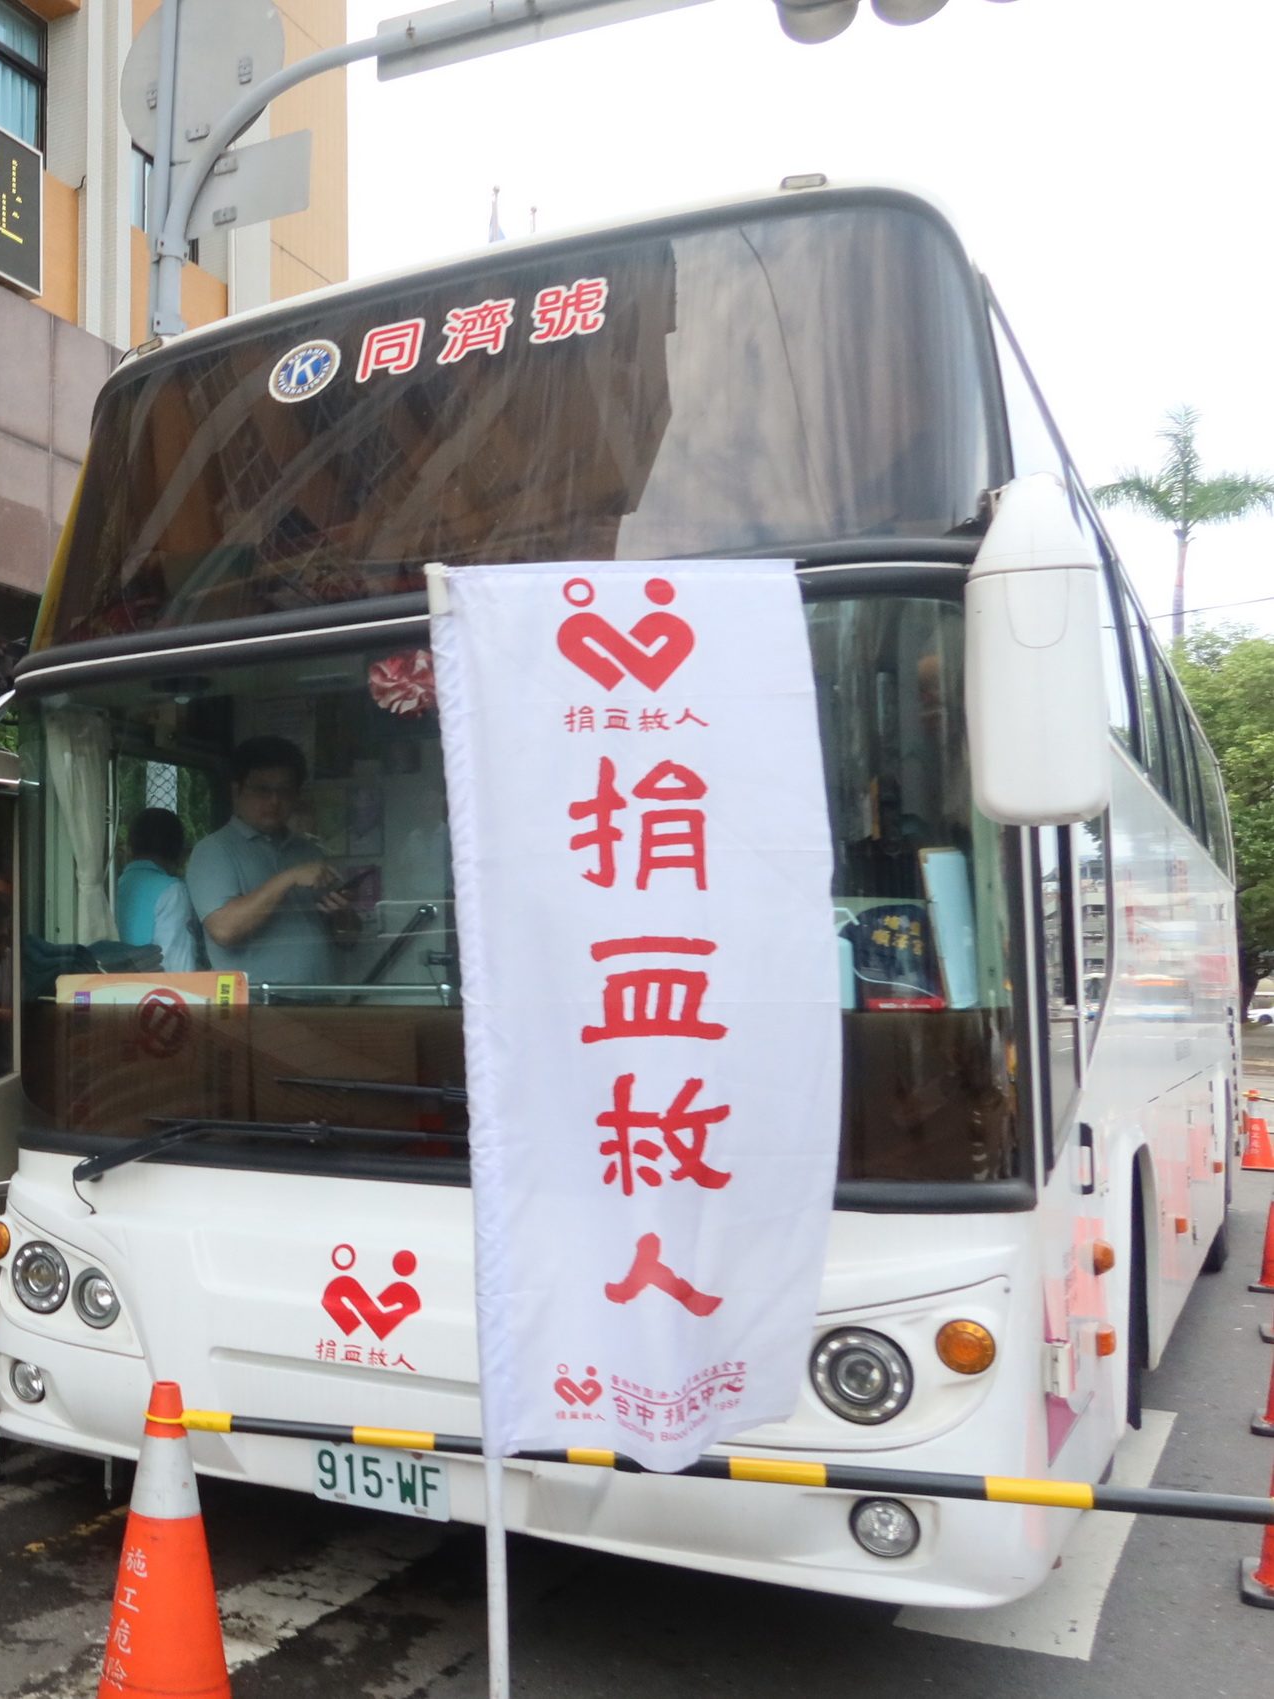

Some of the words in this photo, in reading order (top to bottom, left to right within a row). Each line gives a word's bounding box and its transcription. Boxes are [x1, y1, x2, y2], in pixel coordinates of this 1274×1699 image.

[358, 280, 608, 382] 同濟號
[289, 355, 319, 388] K
[564, 705, 710, 733] 捐血救人
[567, 755, 732, 1317] 捐血救人
[314, 1338, 417, 1372] 捐血救人
[317, 1448, 440, 1508] 915-WF
[104, 1545, 149, 1692] 施工危險
